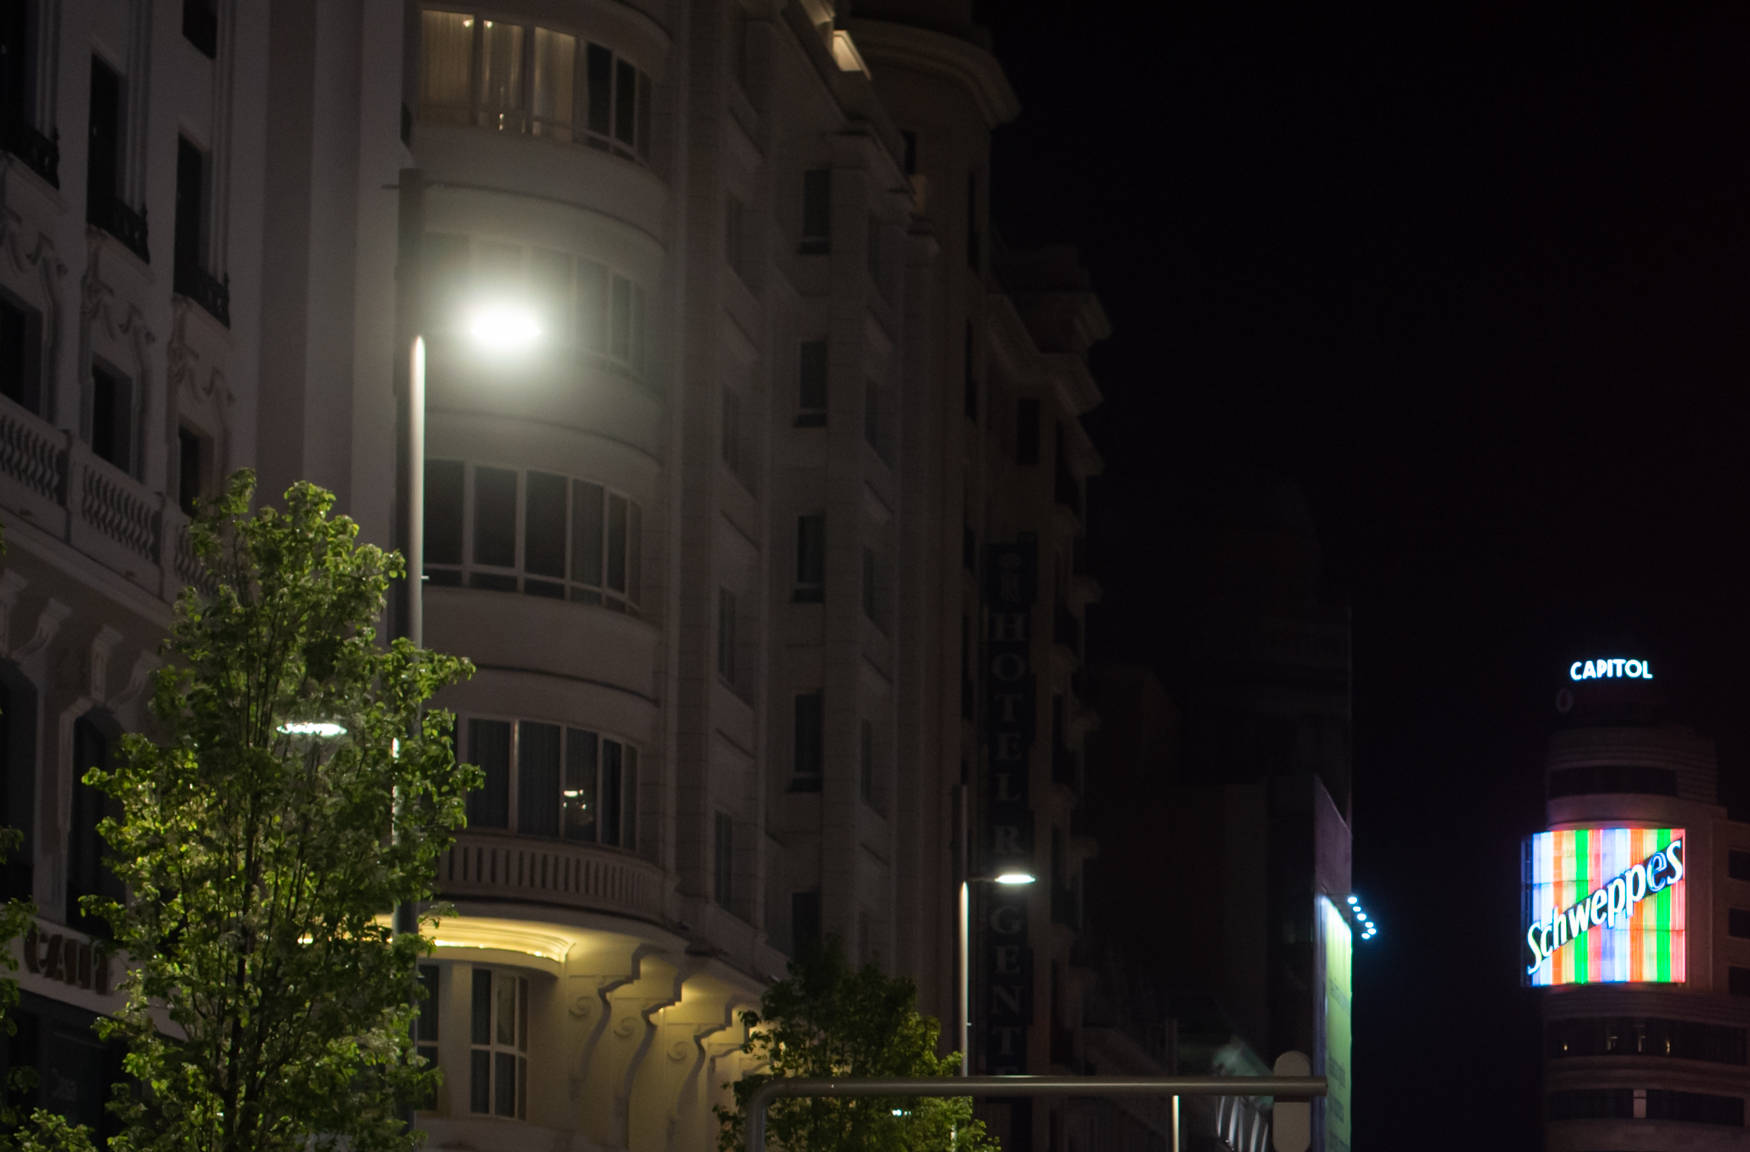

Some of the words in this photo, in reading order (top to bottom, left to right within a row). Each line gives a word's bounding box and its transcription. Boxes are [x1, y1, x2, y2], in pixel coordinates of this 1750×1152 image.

[992, 613, 1027, 801] HOTEL
[1570, 659, 1653, 680] CAPITOL
[991, 825, 1027, 1076] RGENT
[1527, 840, 1683, 975] Schweppes
